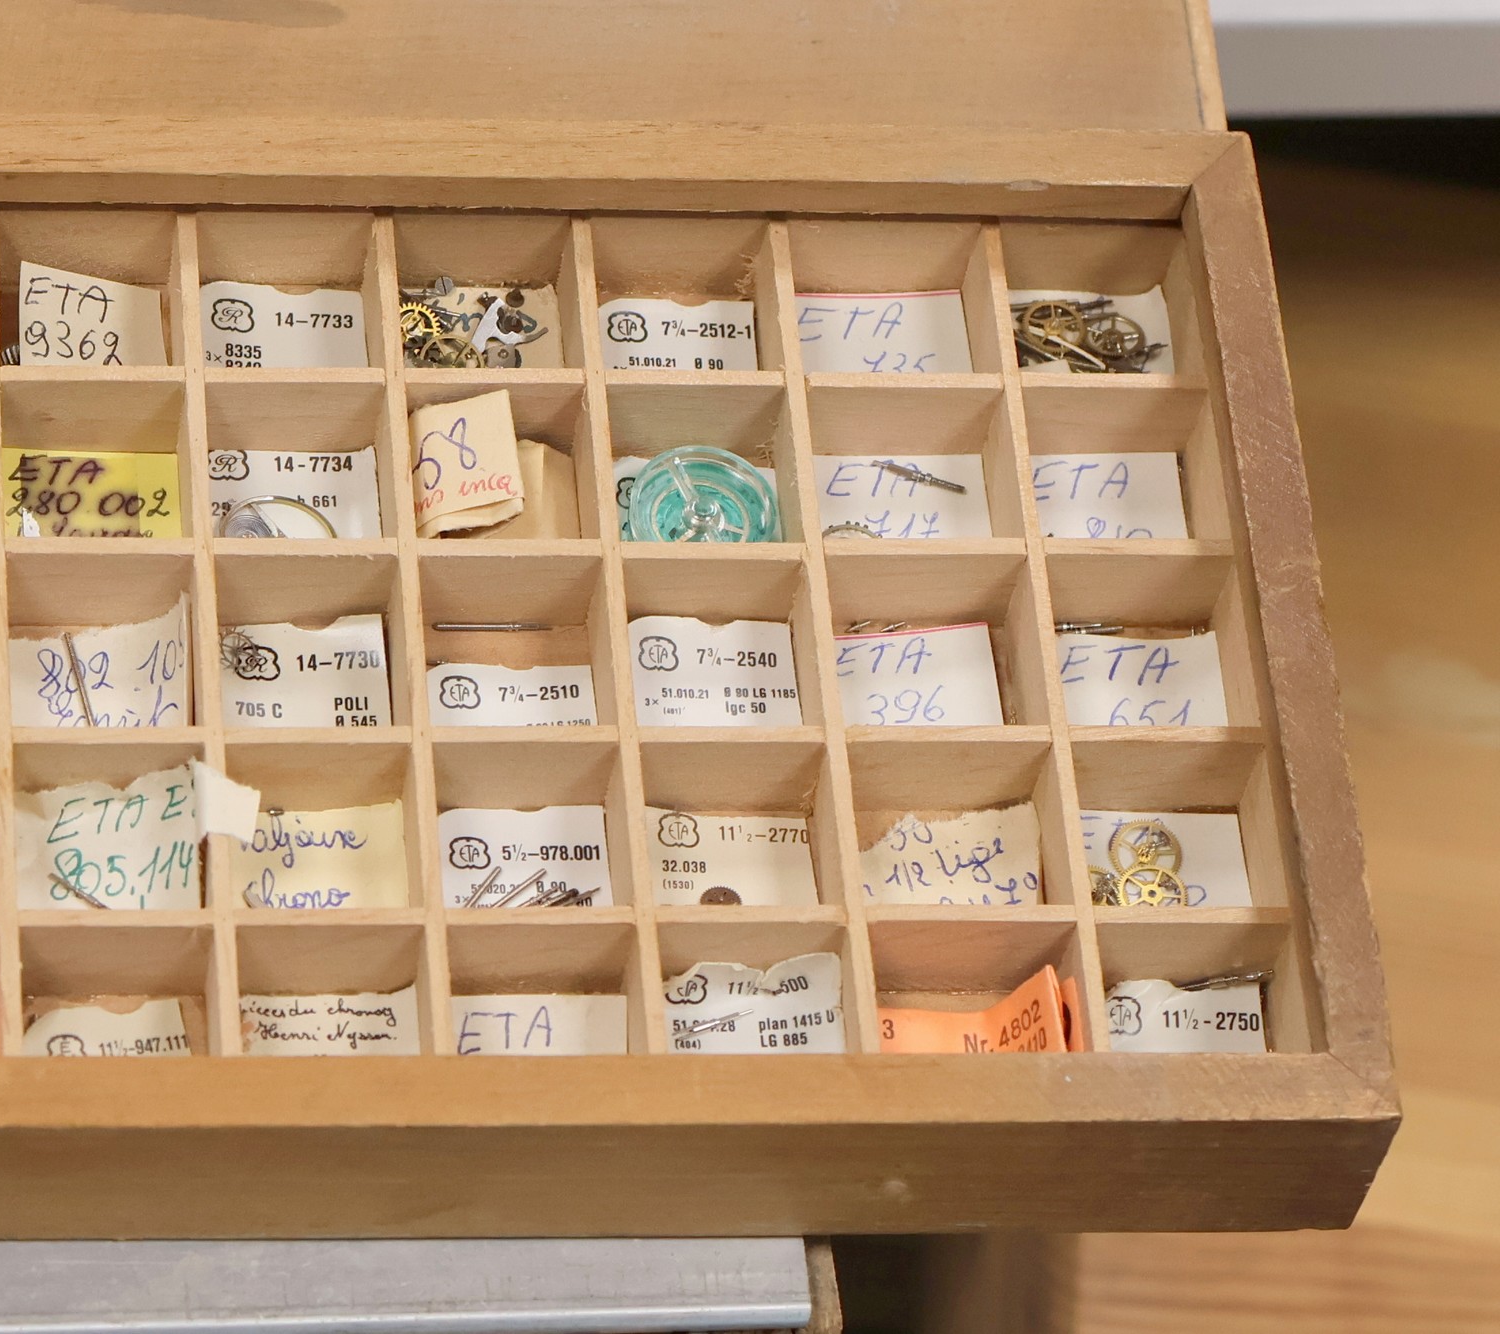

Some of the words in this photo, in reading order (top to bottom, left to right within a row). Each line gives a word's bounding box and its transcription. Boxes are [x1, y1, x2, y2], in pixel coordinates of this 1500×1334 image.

[24, 277, 115, 323] ETA
[798, 301, 903, 342] ETA
[225, 344, 262, 360] 8335
[629, 357, 676, 368] 51.010.21
[708, 359, 724, 370] 90
[8, 454, 104, 485] ETA
[1032, 460, 1130, 500] ETA
[312, 494, 338, 508] 661
[836, 637, 932, 676] ETA
[1061, 644, 1180, 686] ETA
[662, 688, 709, 699] 51.010.21
[770, 688, 796, 700] 1185
[235, 702, 266, 718] 705
[271, 703, 282, 718] C
[334, 697, 368, 712] POLI
[750, 701, 766, 714] 50
[350, 715, 377, 727] 545
[47, 797, 149, 844] ETA
[662, 860, 707, 874] 32.038
[663, 879, 694, 891] (1530)
[458, 1006, 552, 1055] ETA
[759, 1019, 790, 1034] plan
[793, 1014, 823, 1030] 1415
[882, 1019, 895, 1040] 3
[999, 999, 1042, 1048] 4802
[760, 1033, 777, 1048] LG
[783, 1033, 808, 1047] 885
